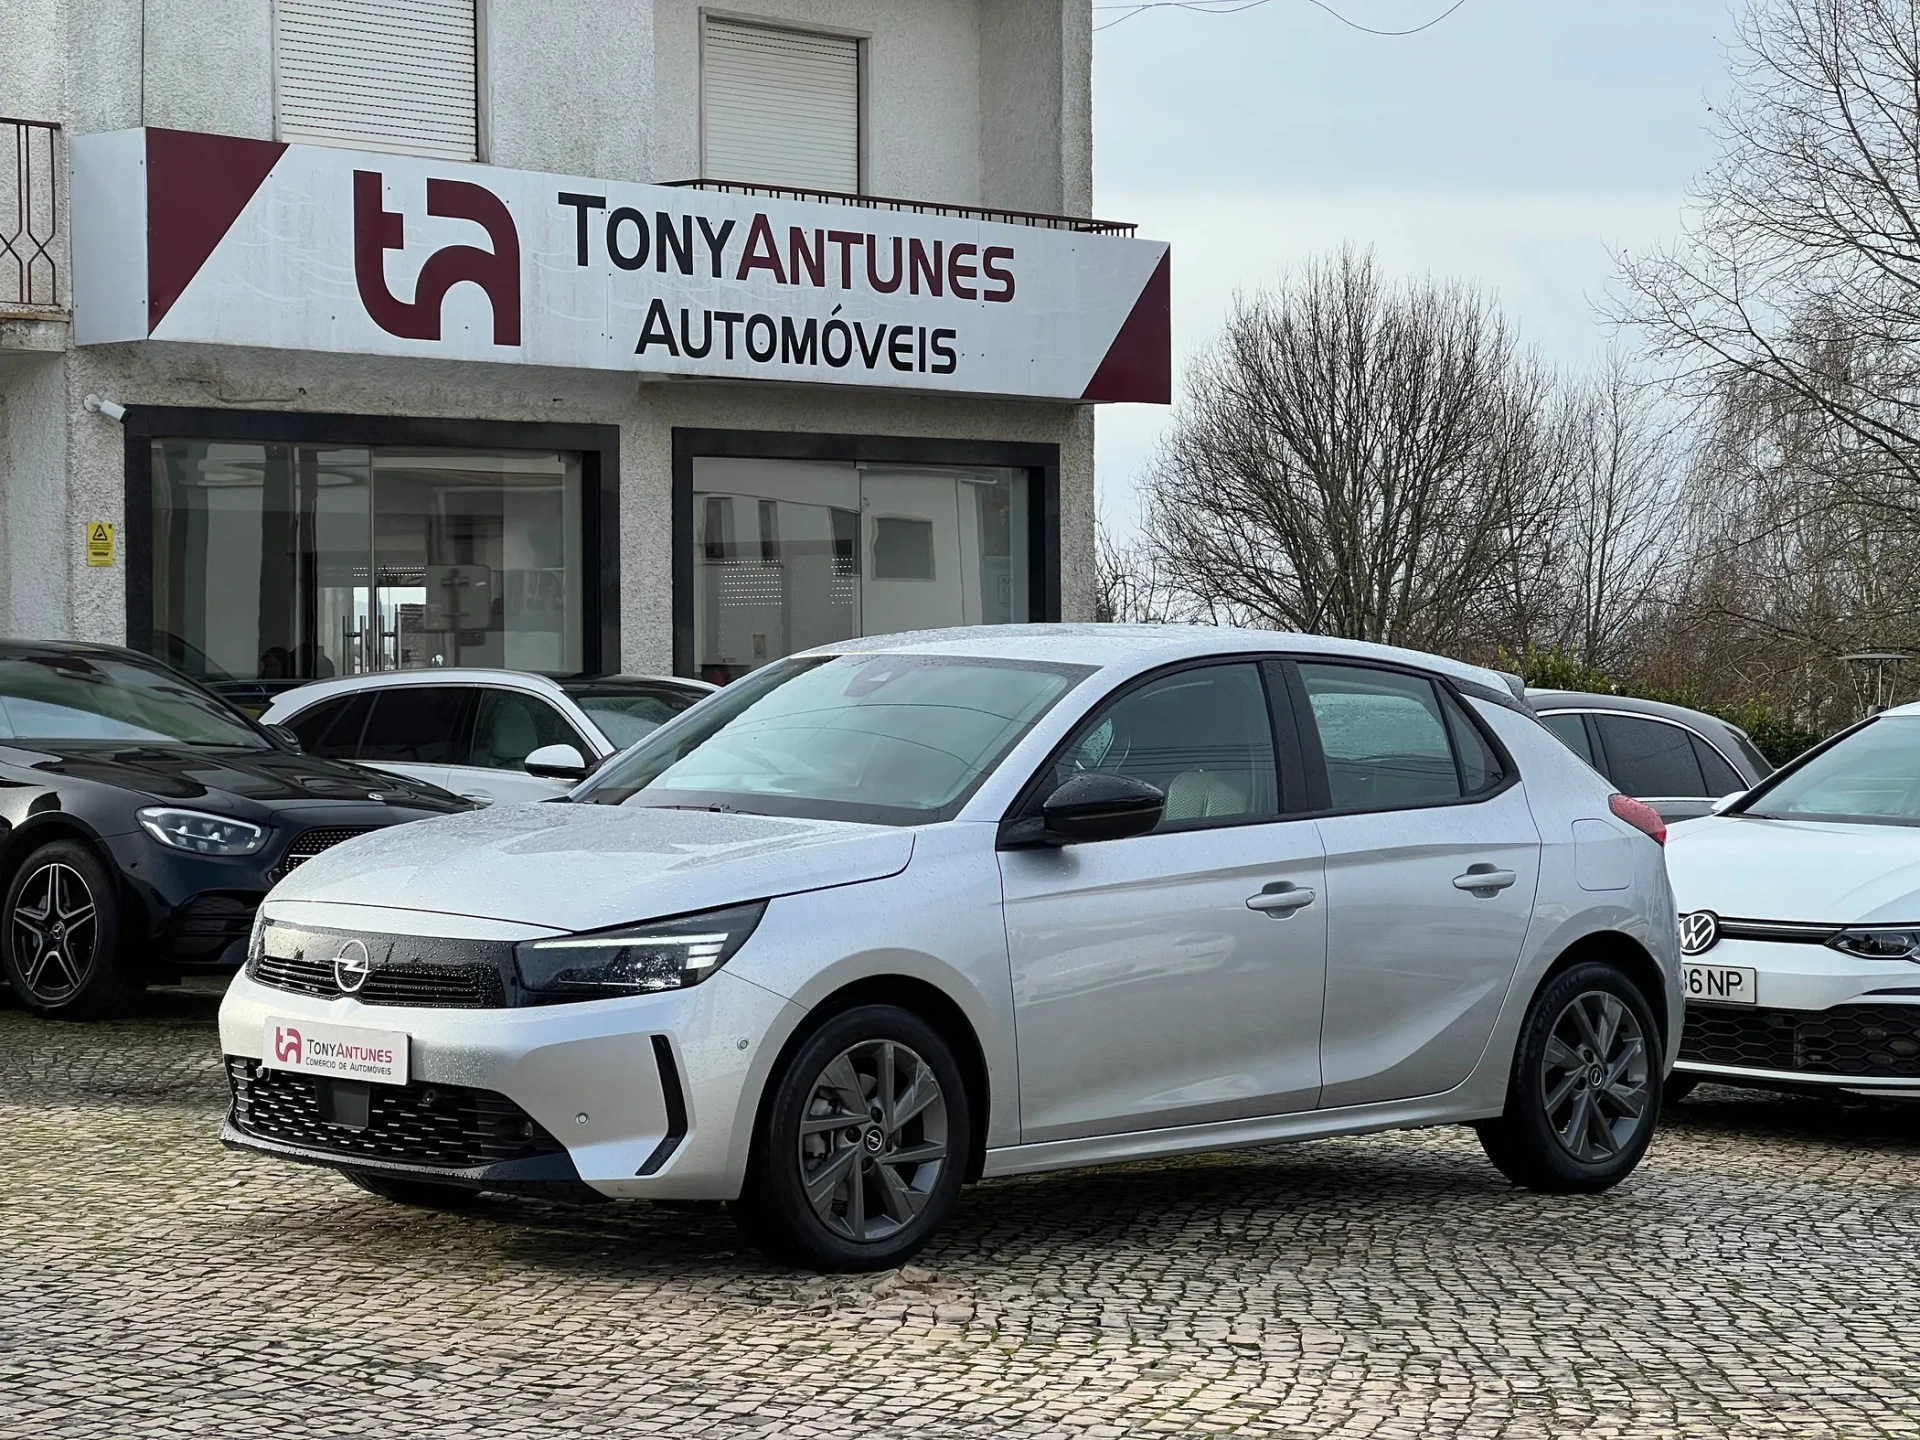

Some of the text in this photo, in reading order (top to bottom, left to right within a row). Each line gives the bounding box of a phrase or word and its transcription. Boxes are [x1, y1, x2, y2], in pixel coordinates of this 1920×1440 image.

[635, 299, 957, 375] AUTOMÓVEIS
[1683, 968, 1703, 994] 6
[338, 1061, 347, 1071] DE
